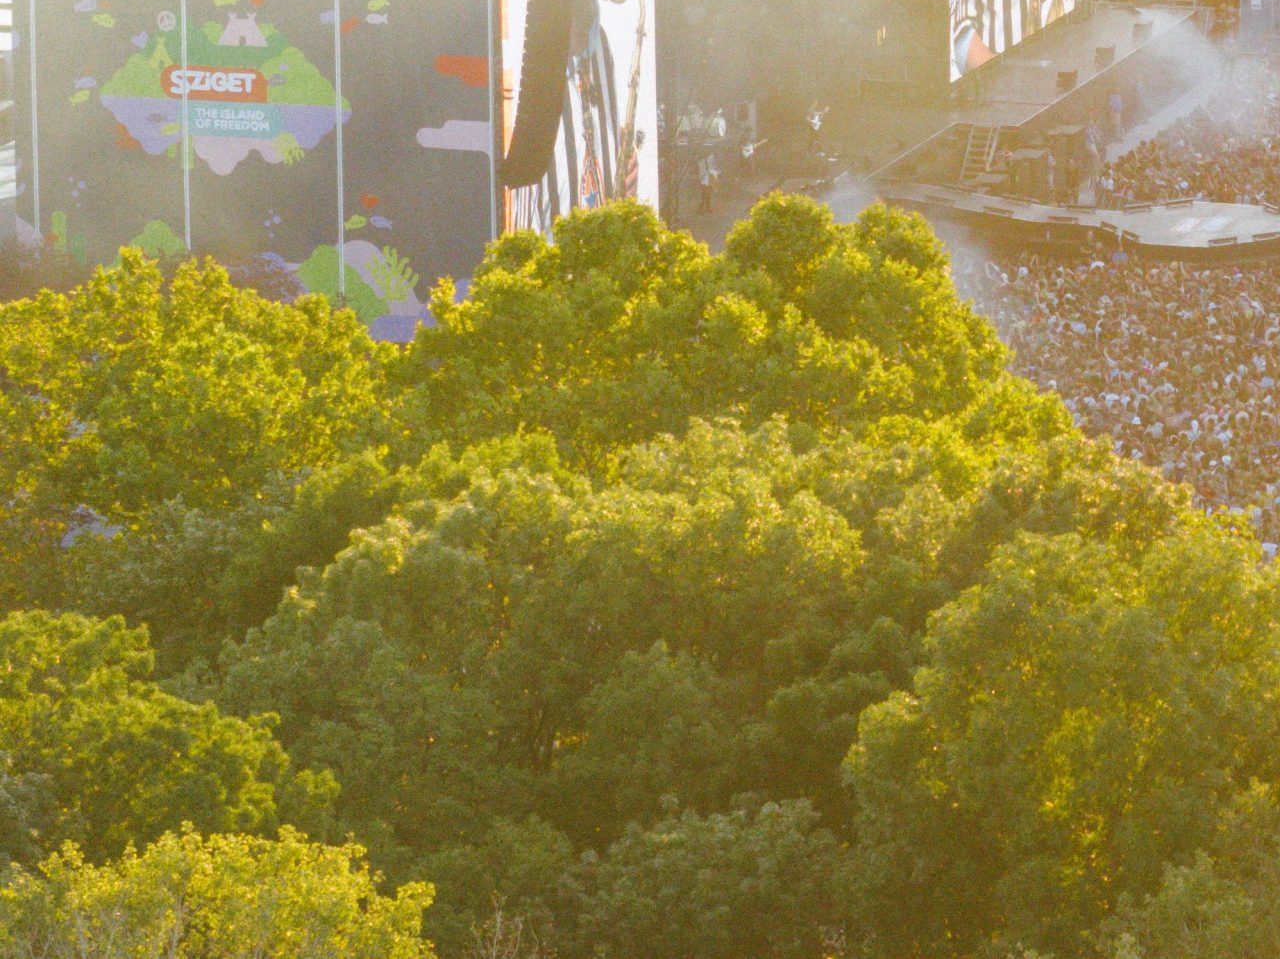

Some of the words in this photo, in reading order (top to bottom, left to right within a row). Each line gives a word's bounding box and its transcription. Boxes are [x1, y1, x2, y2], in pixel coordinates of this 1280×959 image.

[196, 108, 218, 119] THE
[221, 109, 264, 120] ISLAND
[196, 119, 212, 129] OF
[214, 120, 270, 131] FREEDOM
